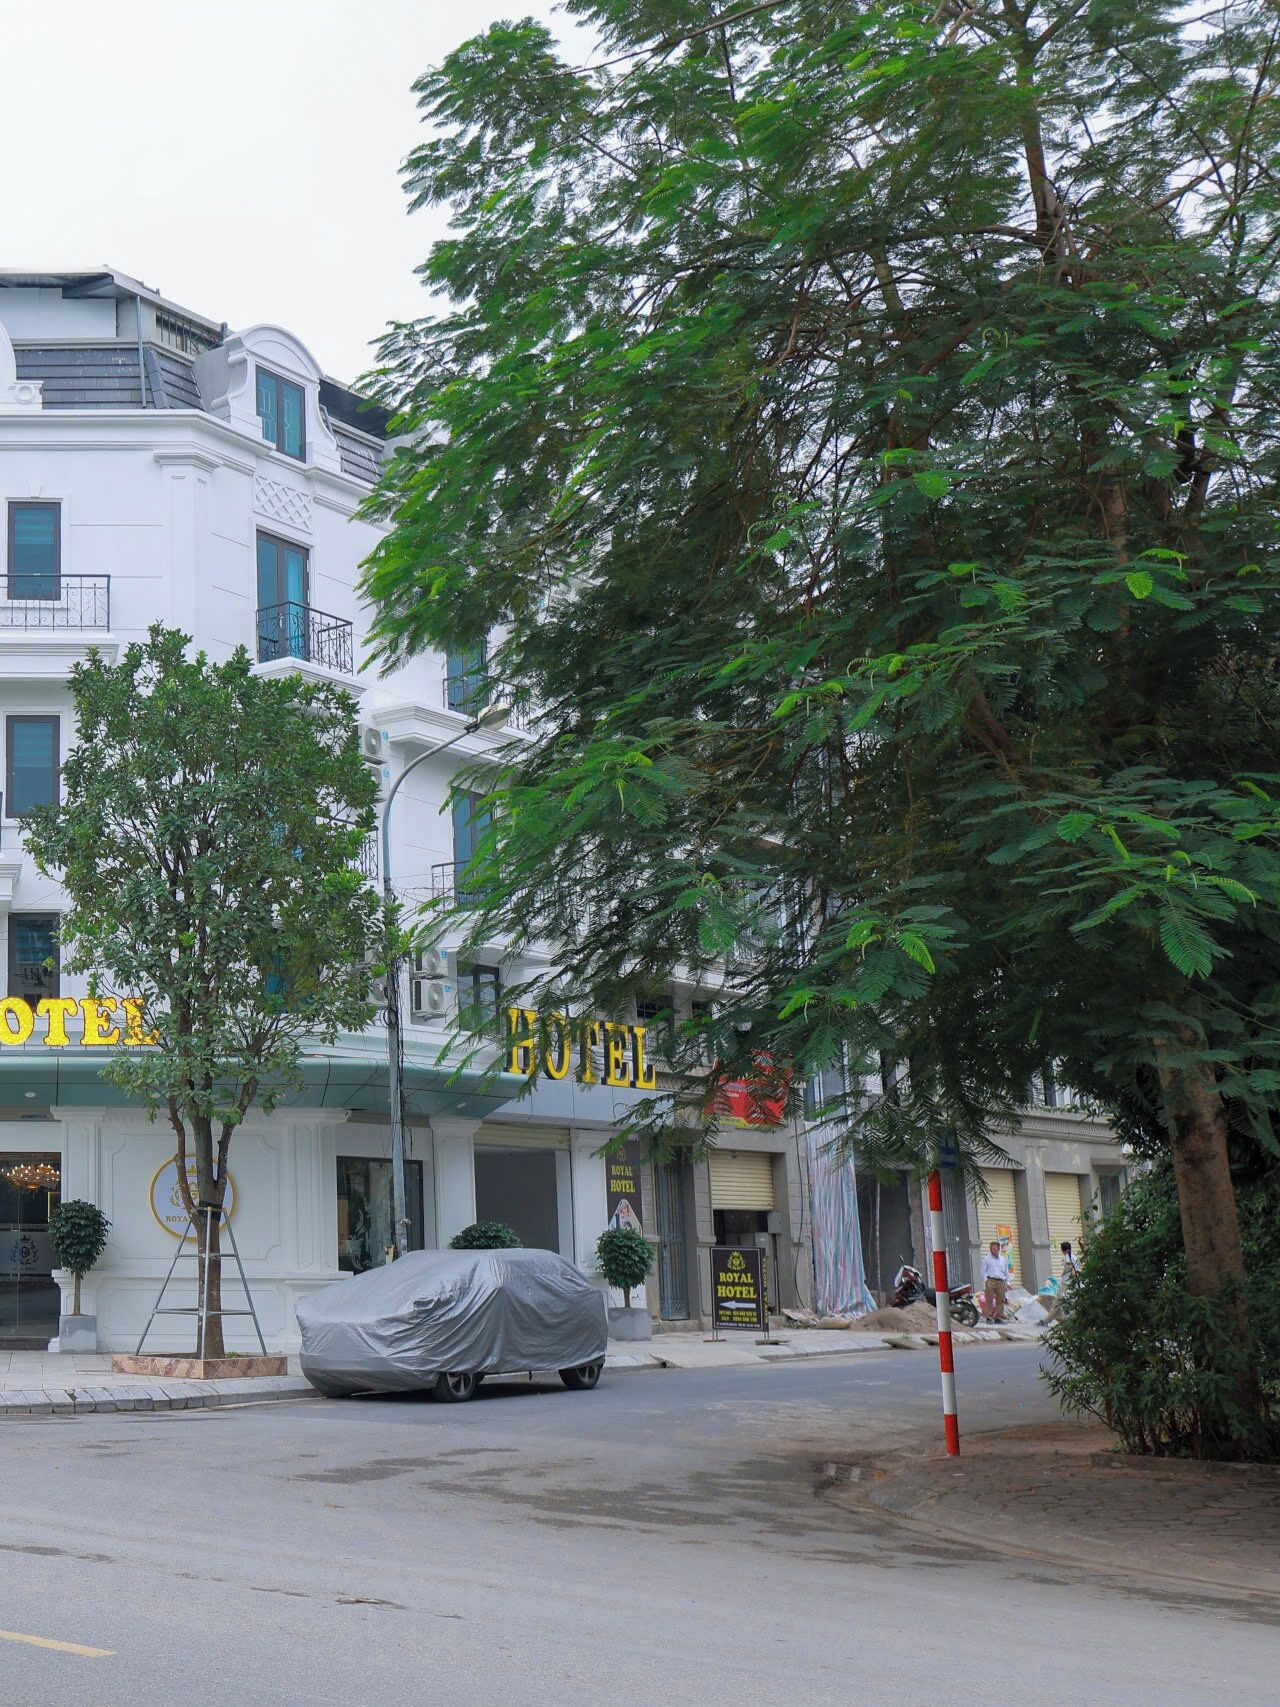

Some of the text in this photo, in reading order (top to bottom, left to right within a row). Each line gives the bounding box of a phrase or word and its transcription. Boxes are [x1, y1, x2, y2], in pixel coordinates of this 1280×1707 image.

[506, 1007, 656, 1090] HOTEL
[611, 1165, 632, 1176] ROYAL
[610, 1179, 635, 1192] HOTEL
[166, 1215, 189, 1223] ROYA
[719, 1272, 754, 1283] ROYAL
[717, 1286, 757, 1299] HOTEL
